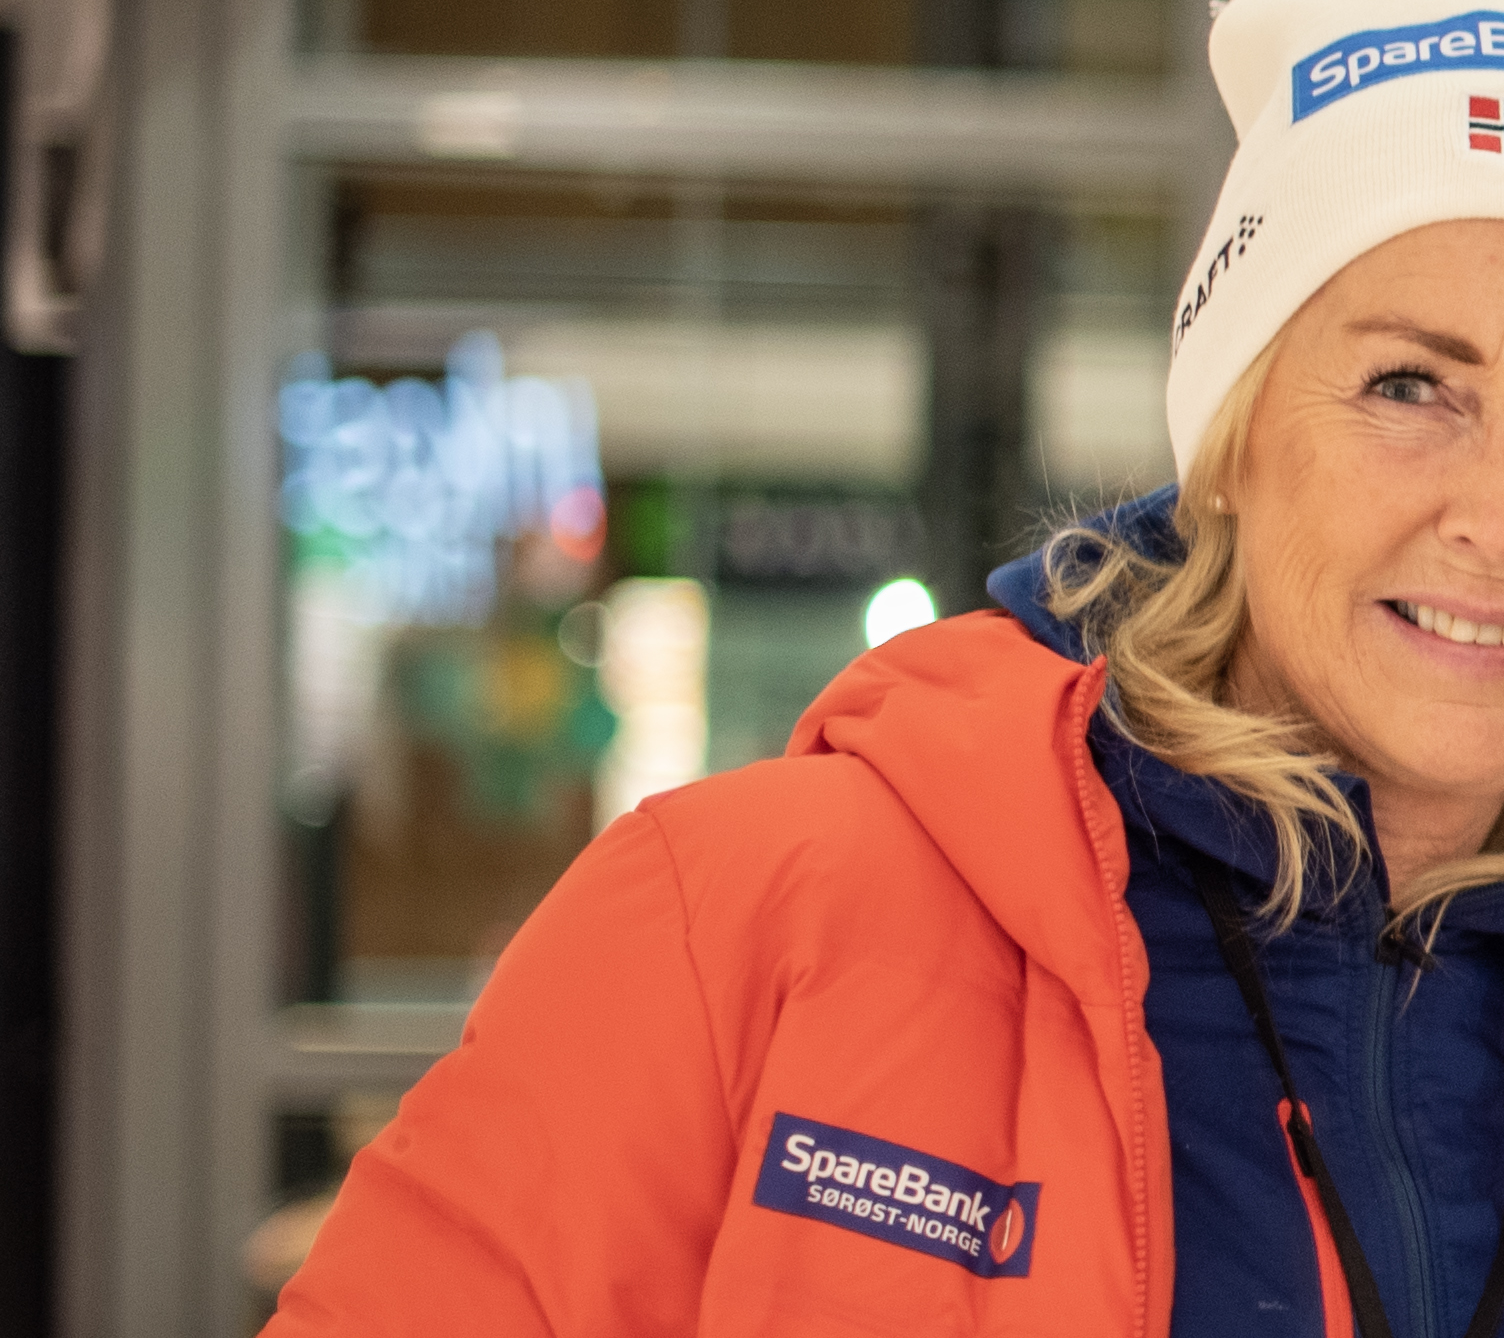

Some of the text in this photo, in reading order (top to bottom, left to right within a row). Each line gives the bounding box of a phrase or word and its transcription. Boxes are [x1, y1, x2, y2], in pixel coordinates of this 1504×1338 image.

[1174, 235, 1234, 358] CRAFT
[781, 1134, 991, 1232] SpareBank
[807, 1184, 983, 1257] SØRØST-NORGE
